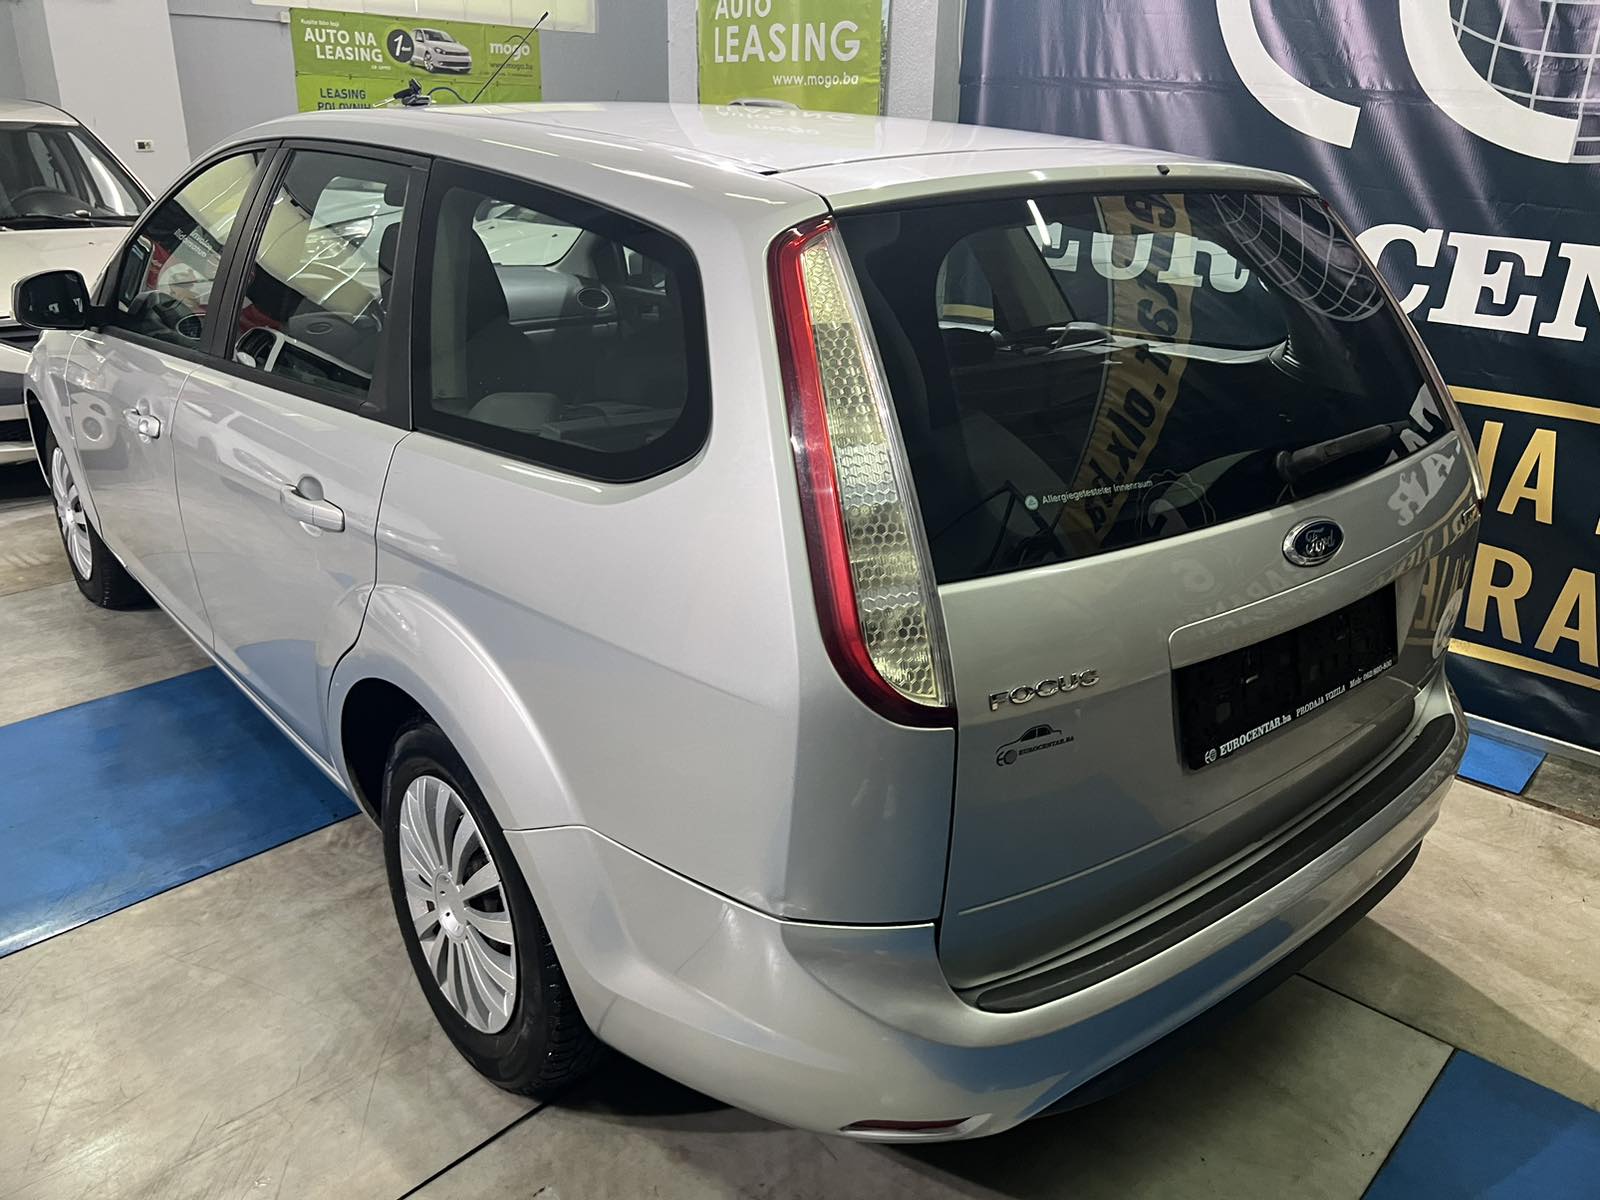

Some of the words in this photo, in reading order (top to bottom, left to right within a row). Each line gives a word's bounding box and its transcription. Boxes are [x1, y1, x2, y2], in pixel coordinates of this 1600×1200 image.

[714, 0, 772, 20] AUTO
[305, 28, 349, 44] AUTO
[355, 31, 377, 47] NA
[714, 20, 861, 64] LEASING
[316, 45, 384, 63] LEASING
[489, 43, 530, 61] mogo
[772, 71, 860, 88] www.mogo.ba
[320, 88, 366, 99] LEASING
[1042, 485, 1112, 504] Allergiegetesteter
[1113, 480, 1153, 492] Innenraum
[989, 669, 1100, 712] FOCUS
[1220, 714, 1292, 757] EUROCENTAR.ba
[1296, 696, 1325, 717] PRODAJA
